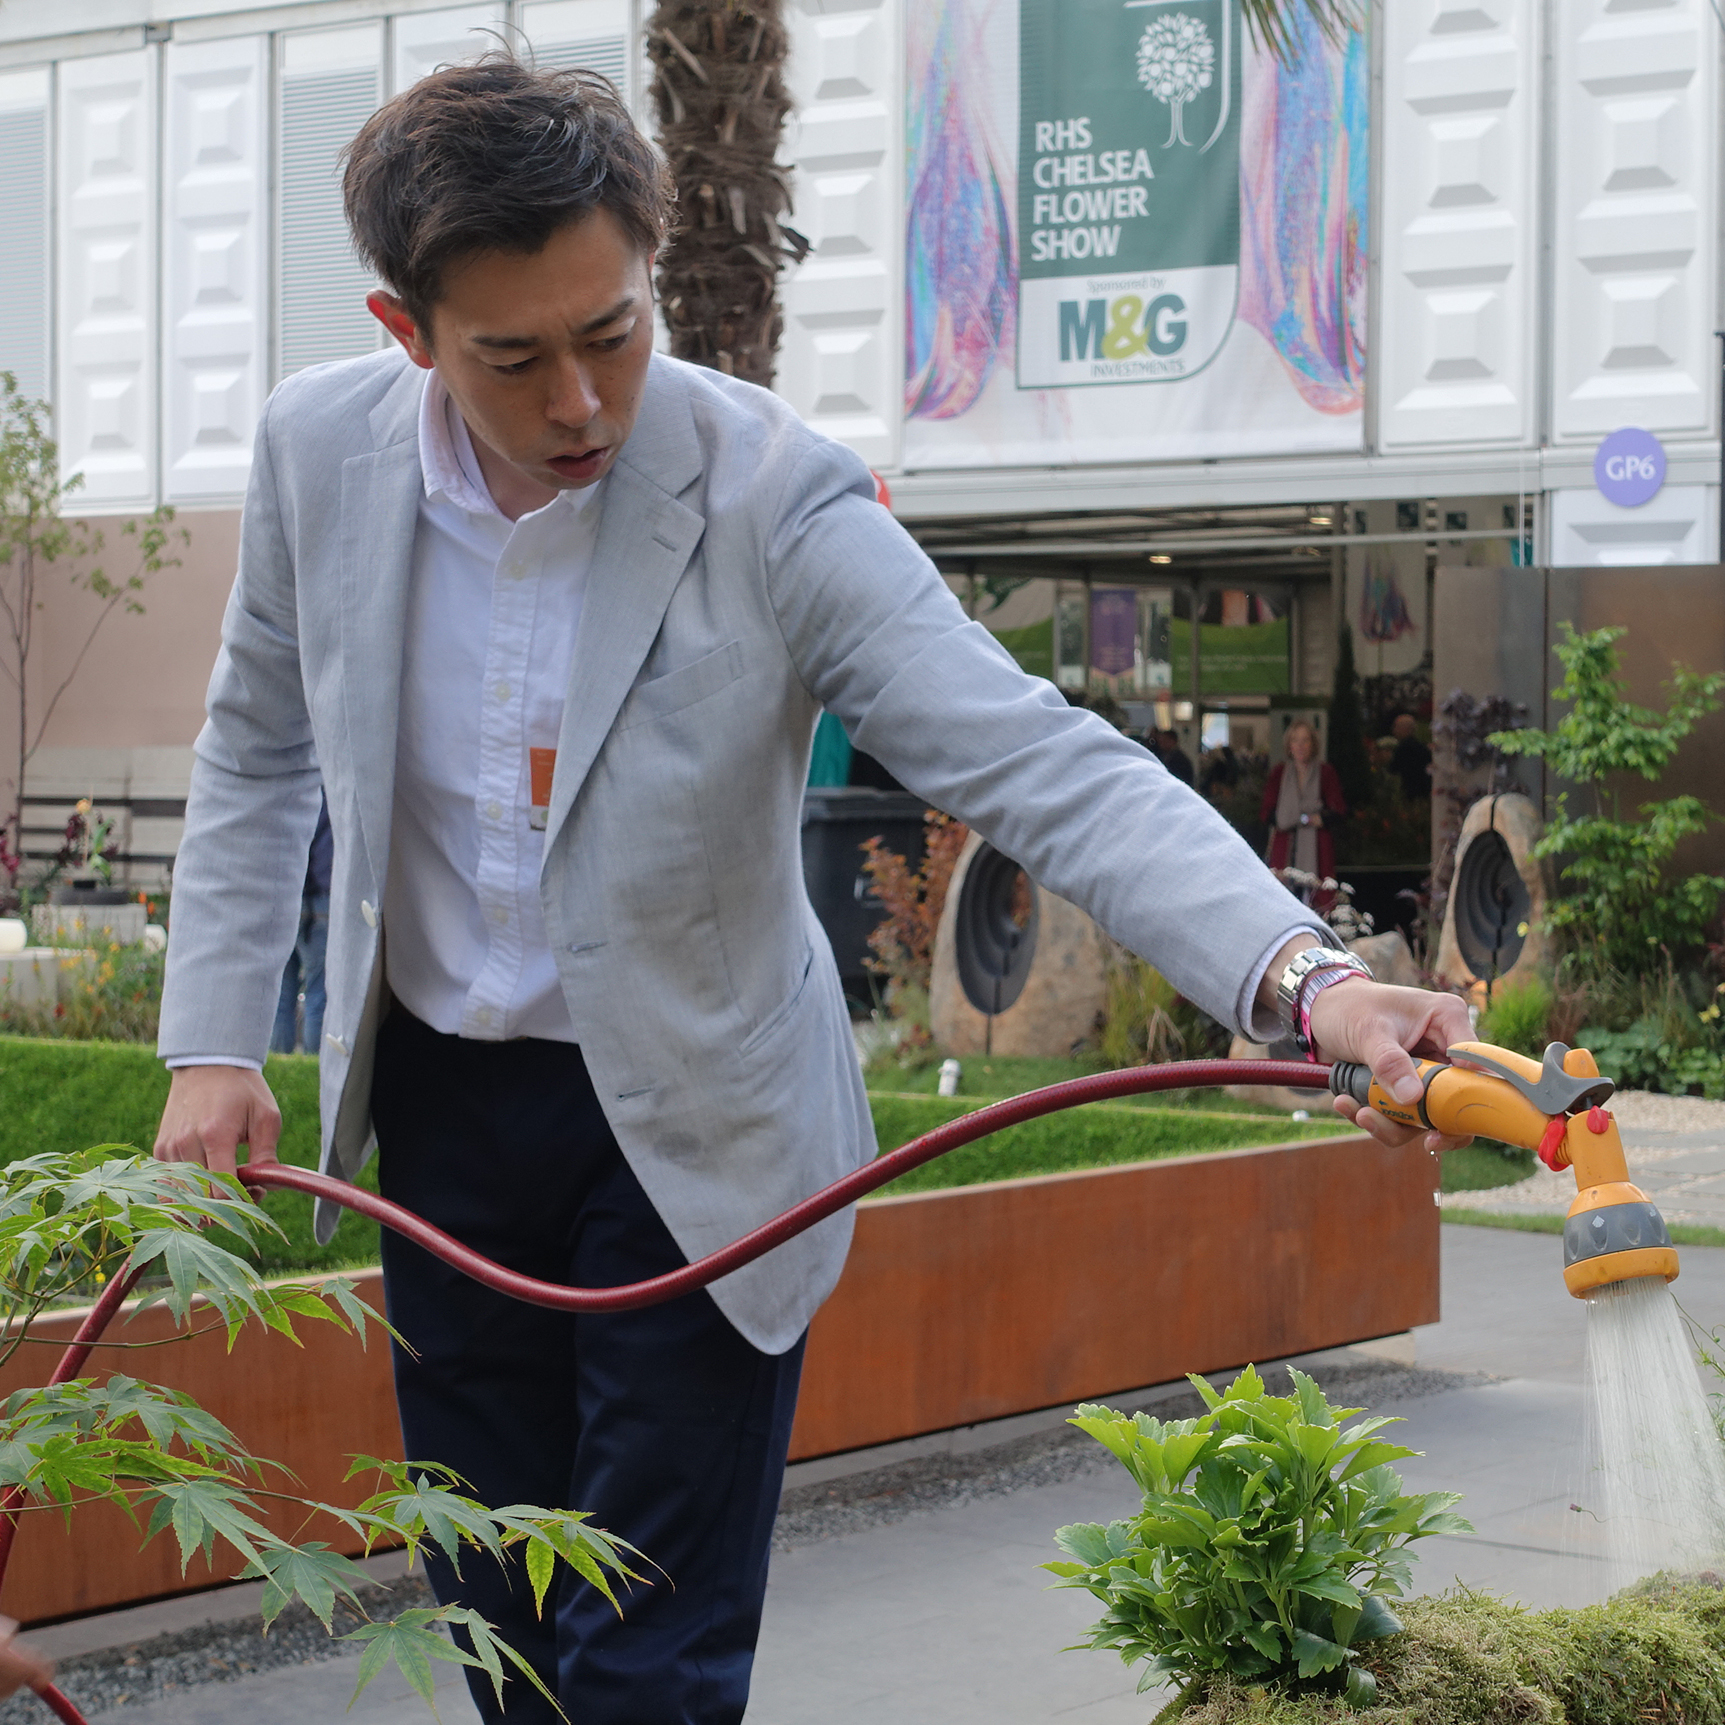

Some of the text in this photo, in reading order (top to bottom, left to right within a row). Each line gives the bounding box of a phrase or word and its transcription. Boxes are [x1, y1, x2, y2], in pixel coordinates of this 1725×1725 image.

[1035, 117, 1093, 153] RHS
[1032, 148, 1155, 189] CHELSEA
[1032, 185, 1150, 225] FLOWER
[1030, 224, 1122, 262] SHOW
[1087, 277, 1166, 293] Sponsored by
[1058, 293, 1188, 361] M&G
[1090, 360, 1186, 377] INVESTMENTS
[1605, 453, 1656, 481] GP6
